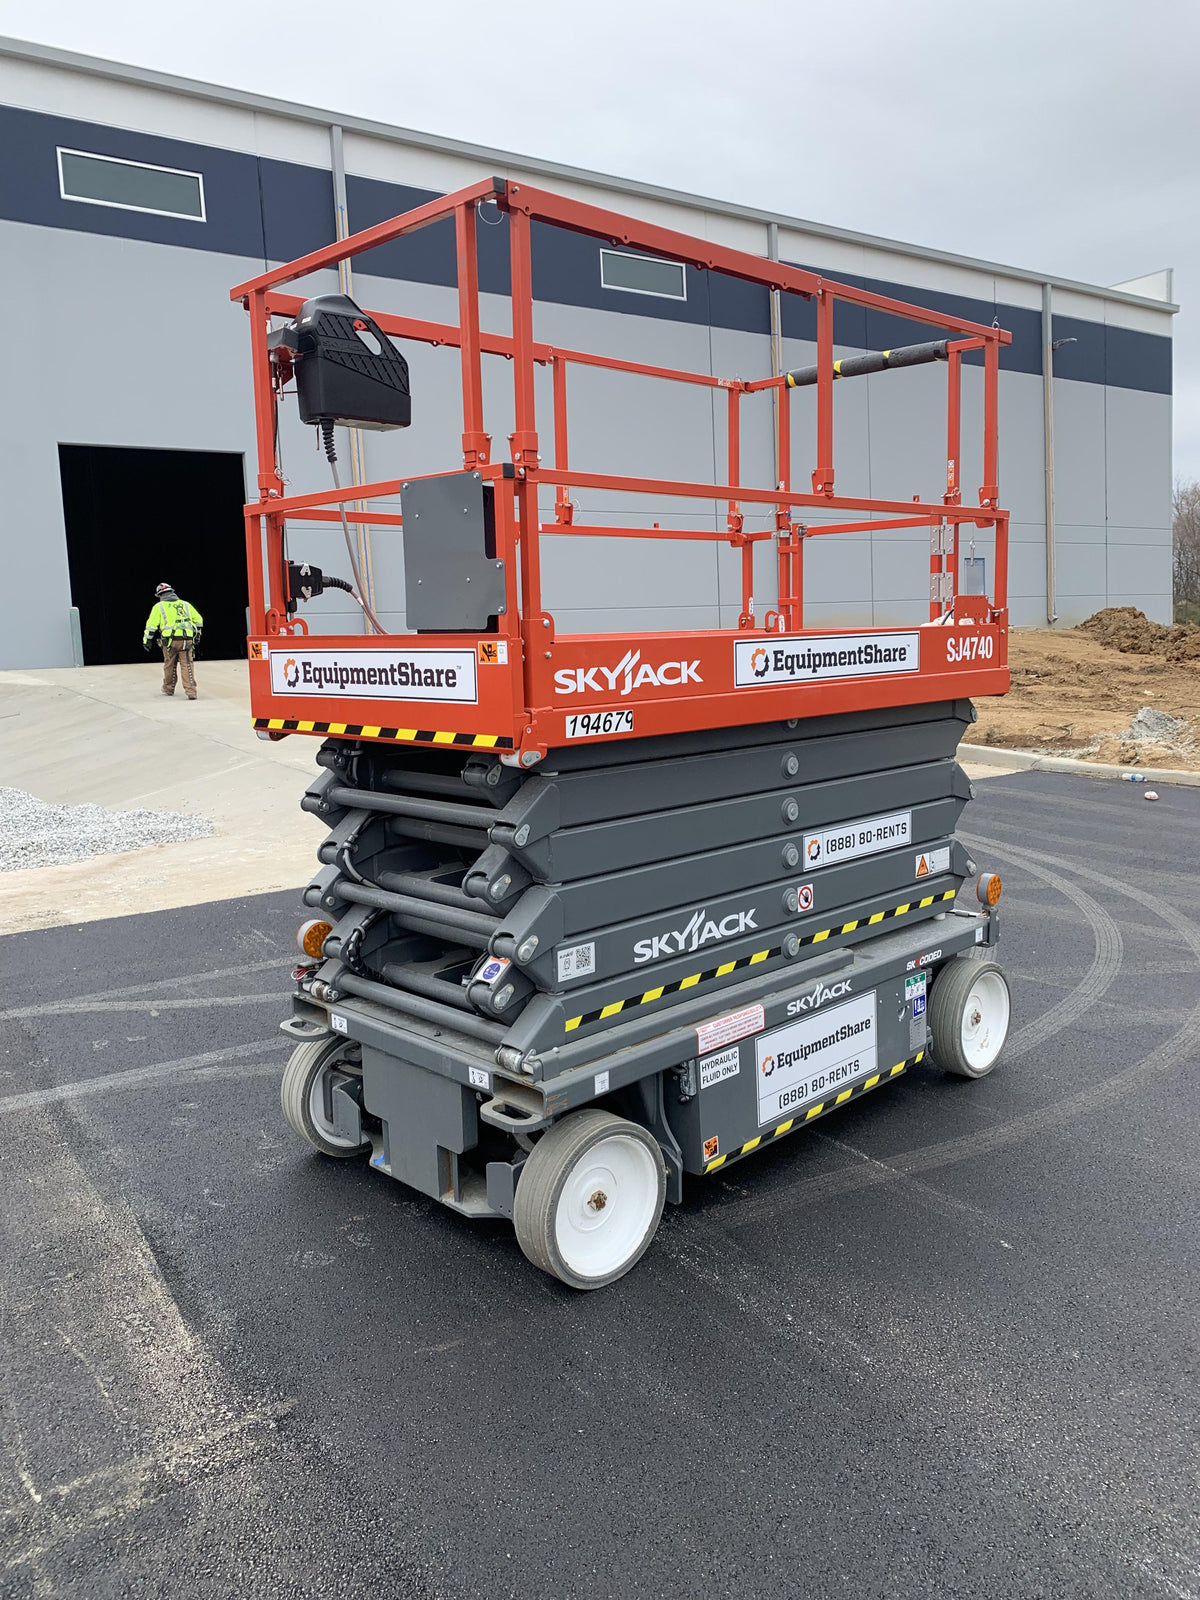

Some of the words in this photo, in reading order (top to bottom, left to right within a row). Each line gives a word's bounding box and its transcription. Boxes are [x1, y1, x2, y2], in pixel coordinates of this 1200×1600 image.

[773, 644, 907, 674] EquipmentShare
[946, 635, 993, 663] SJ4740
[301, 661, 457, 690] EquipmentShare
[553, 648, 704, 696] SKYJACK
[569, 710, 633, 736] 194679
[826, 834, 856, 854] (888)
[859, 822, 907, 845] 80-RENTS
[633, 908, 759, 963] SKYJACK
[786, 979, 852, 1016] SKYJACK
[776, 1018, 871, 1069] EquipmentShare
[701, 1050, 738, 1073] HYDRAULIC
[702, 1070, 721, 1085] FLUID
[721, 1062, 738, 1077] ONLY
[778, 1084, 808, 1109] (888)
[811, 1059, 860, 1092] 80-RENTS
